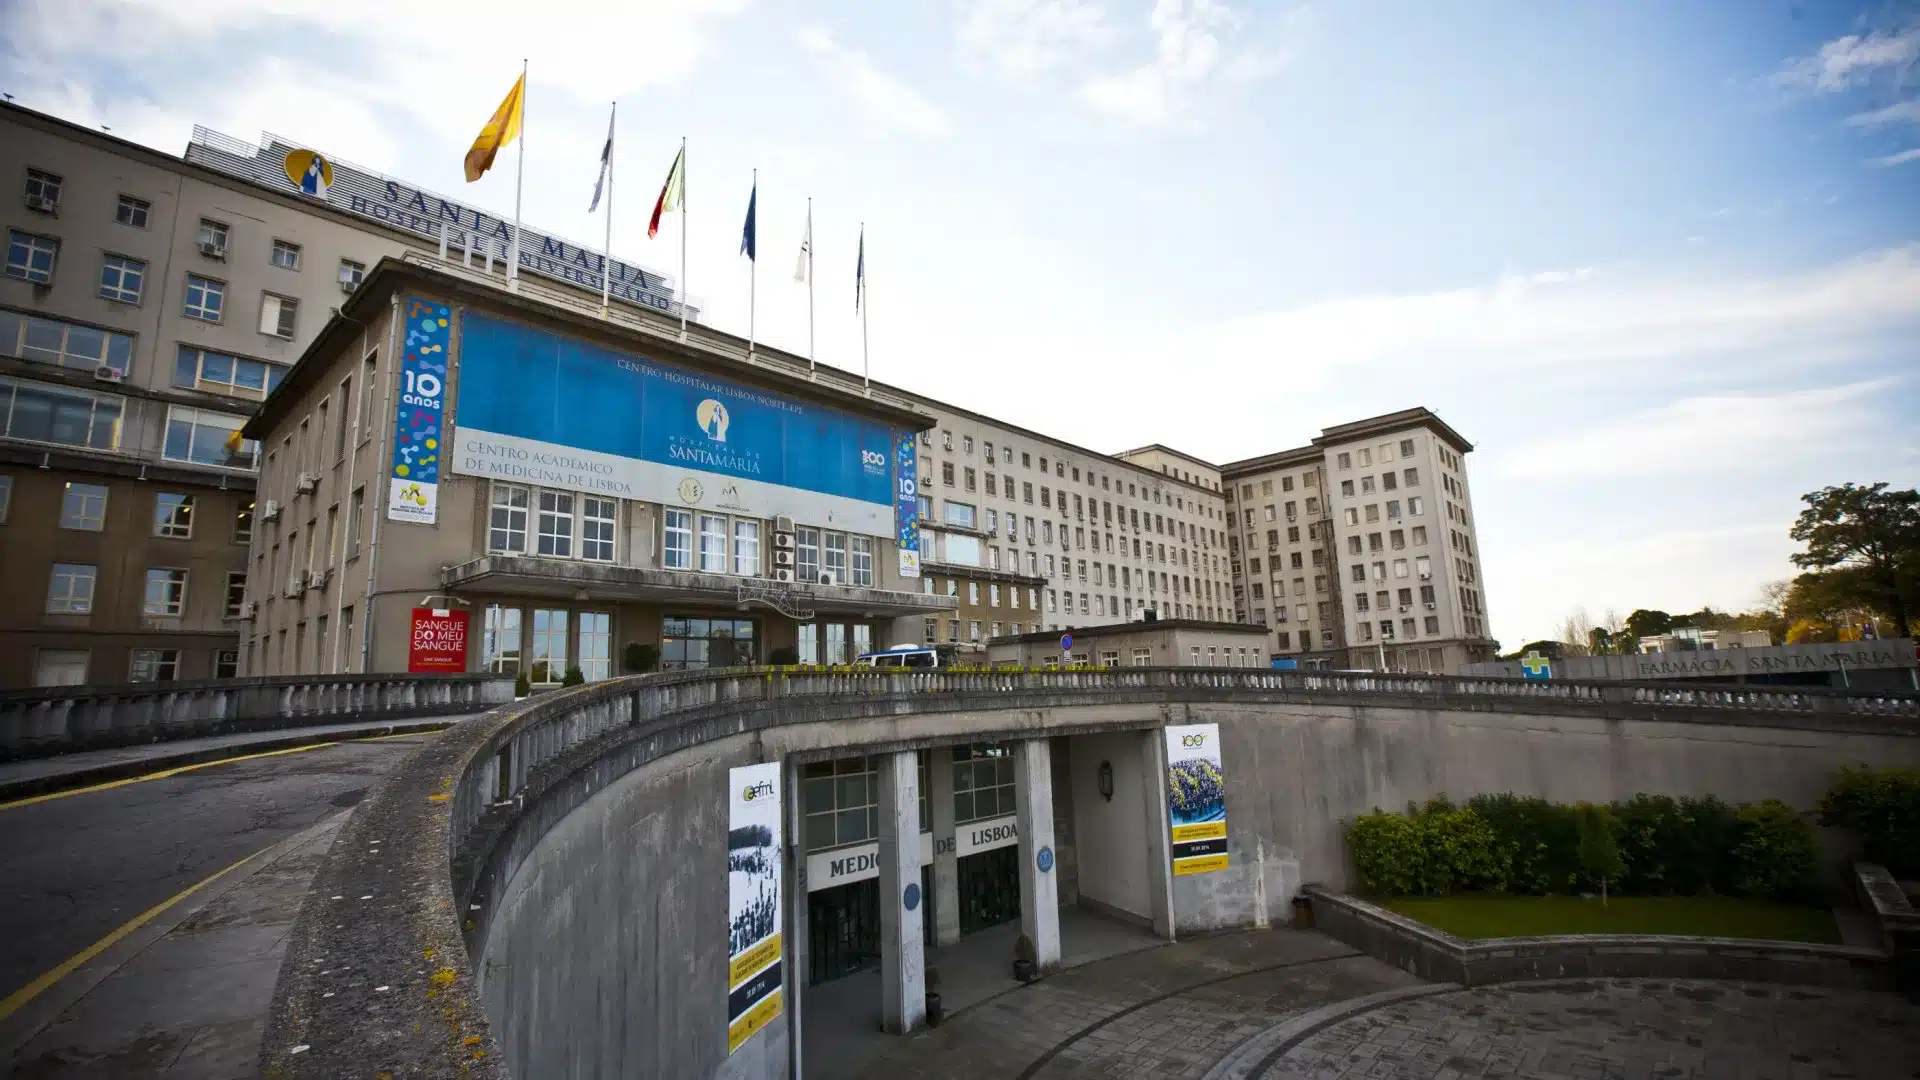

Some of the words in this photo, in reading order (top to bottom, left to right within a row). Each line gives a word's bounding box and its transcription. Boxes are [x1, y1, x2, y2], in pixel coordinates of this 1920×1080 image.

[385, 181, 510, 241] SANTA
[403, 370, 441, 397] 10
[617, 359, 662, 378] CENTRO
[664, 371, 724, 394] HOSPITALAR
[725, 388, 756, 402] LISBOA
[402, 394, 441, 409] anos
[466, 440, 529, 461] CENTRO
[669, 436, 736, 454] HOSPITAL
[669, 444, 761, 474] SANTAMARIA
[465, 457, 485, 471] DE
[489, 461, 563, 484] MEDICINA
[567, 474, 585, 488] DE
[588, 477, 632, 494] LISBOA
[898, 477, 915, 495] 10
[415, 620, 464, 631] SANGUE
[414, 630, 434, 640] DO
[437, 631, 464, 641] MEU
[413, 640, 463, 651] SANGUE
[1749, 654, 1816, 671] SANTA
[936, 837, 956, 855] DE
[972, 823, 1018, 846] LISBOA
